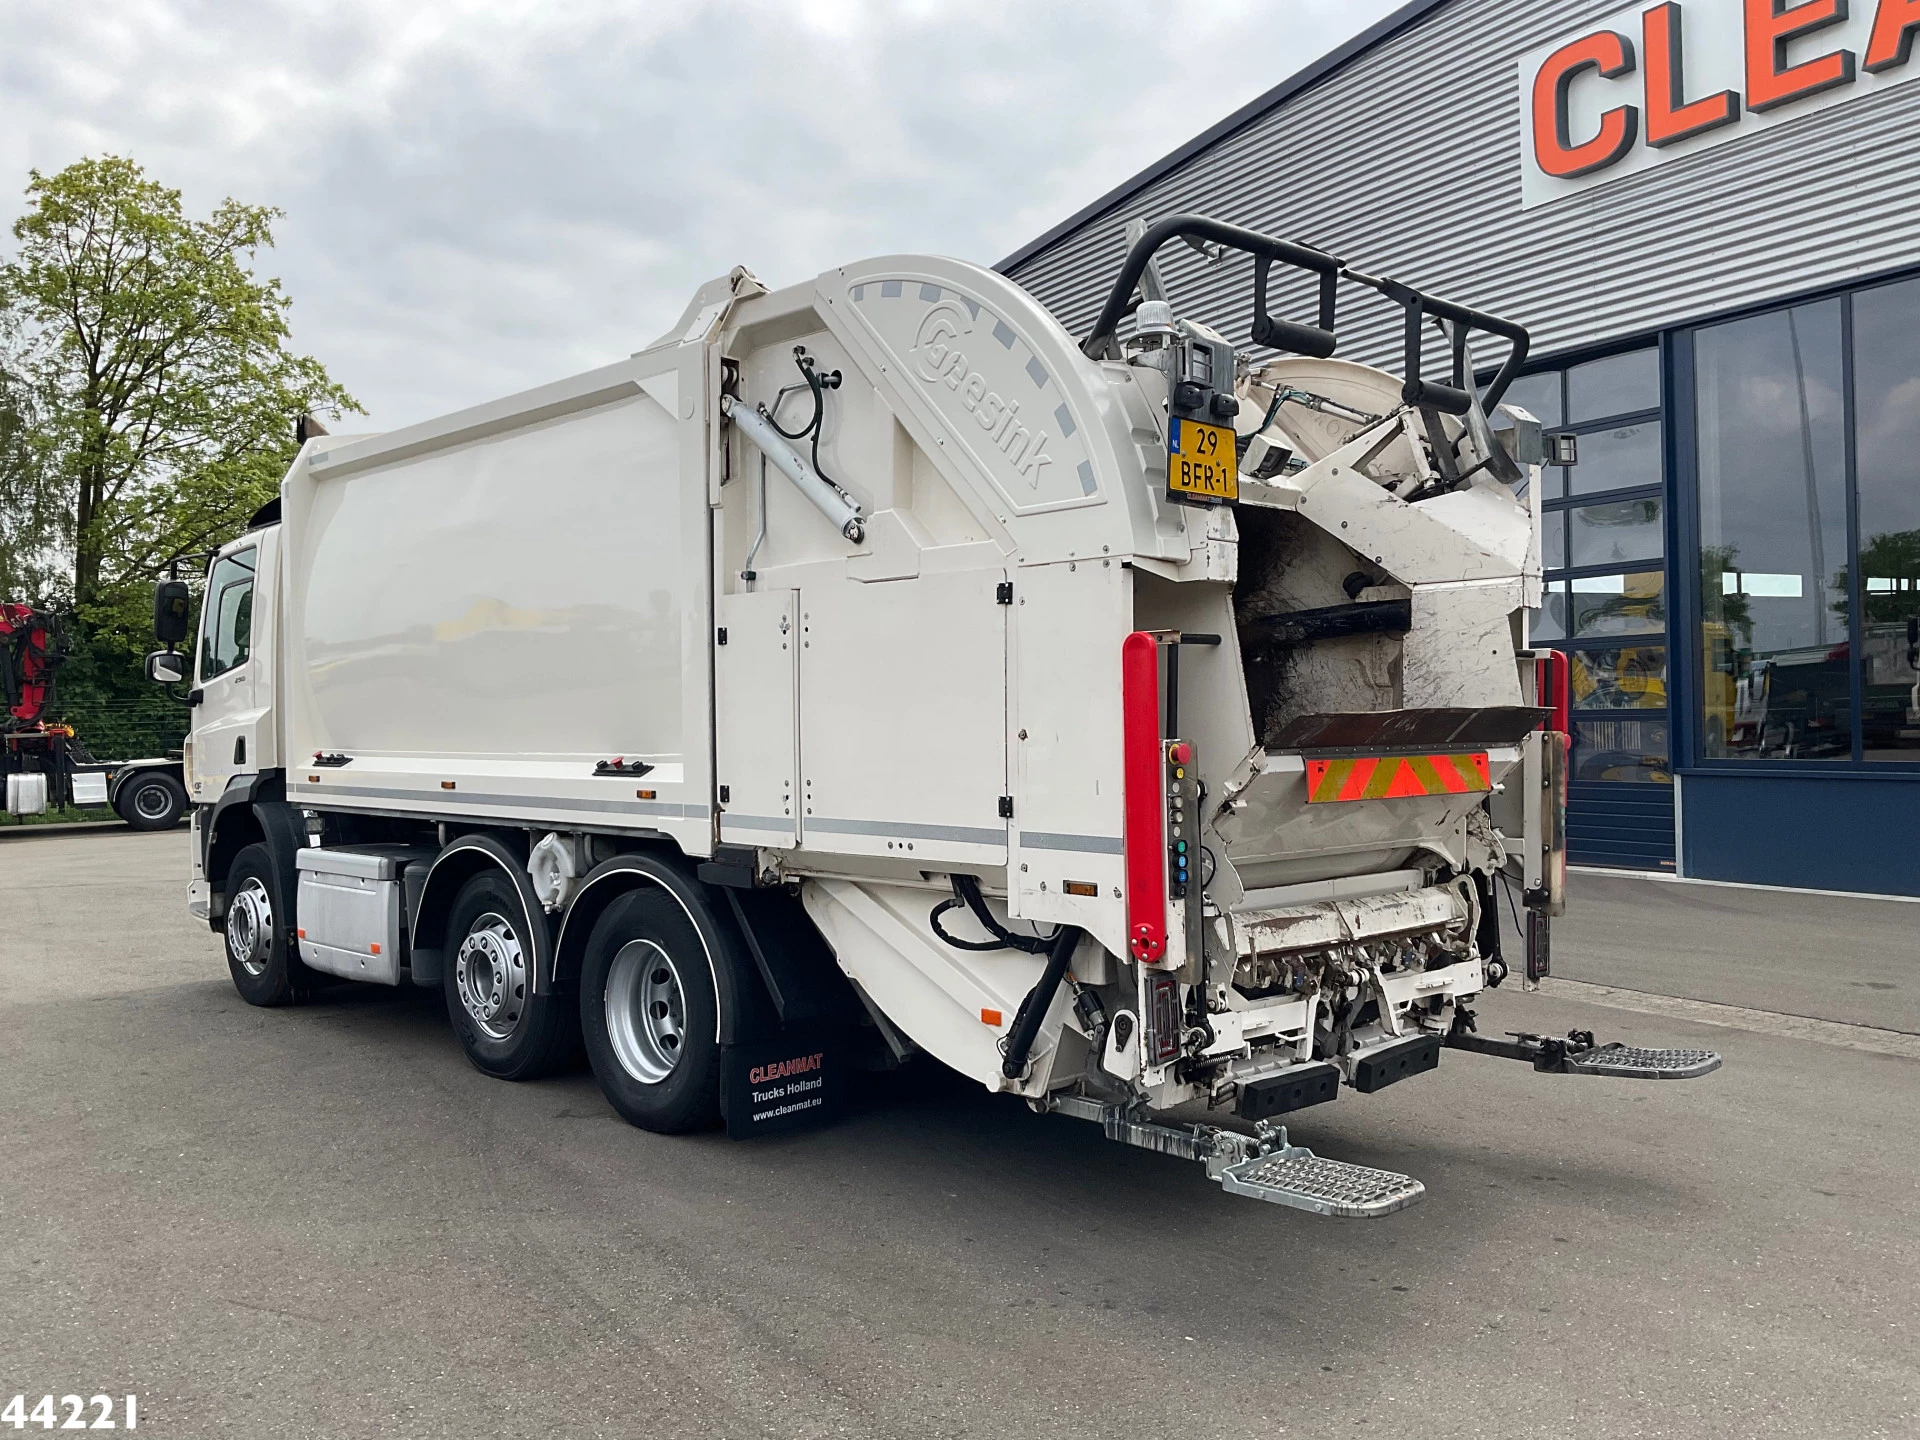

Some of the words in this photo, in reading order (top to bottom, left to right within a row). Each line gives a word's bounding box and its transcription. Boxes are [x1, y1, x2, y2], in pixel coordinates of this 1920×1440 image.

[1172, 439, 1179, 448] NL
[1197, 428, 1218, 456] 29
[1181, 460, 1227, 492] BFR-1
[749, 1053, 823, 1084] CLEANMAT
[752, 1087, 785, 1103] Trucks
[787, 1076, 822, 1094] Holland
[753, 1097, 822, 1121] www.cleanmat.eu
